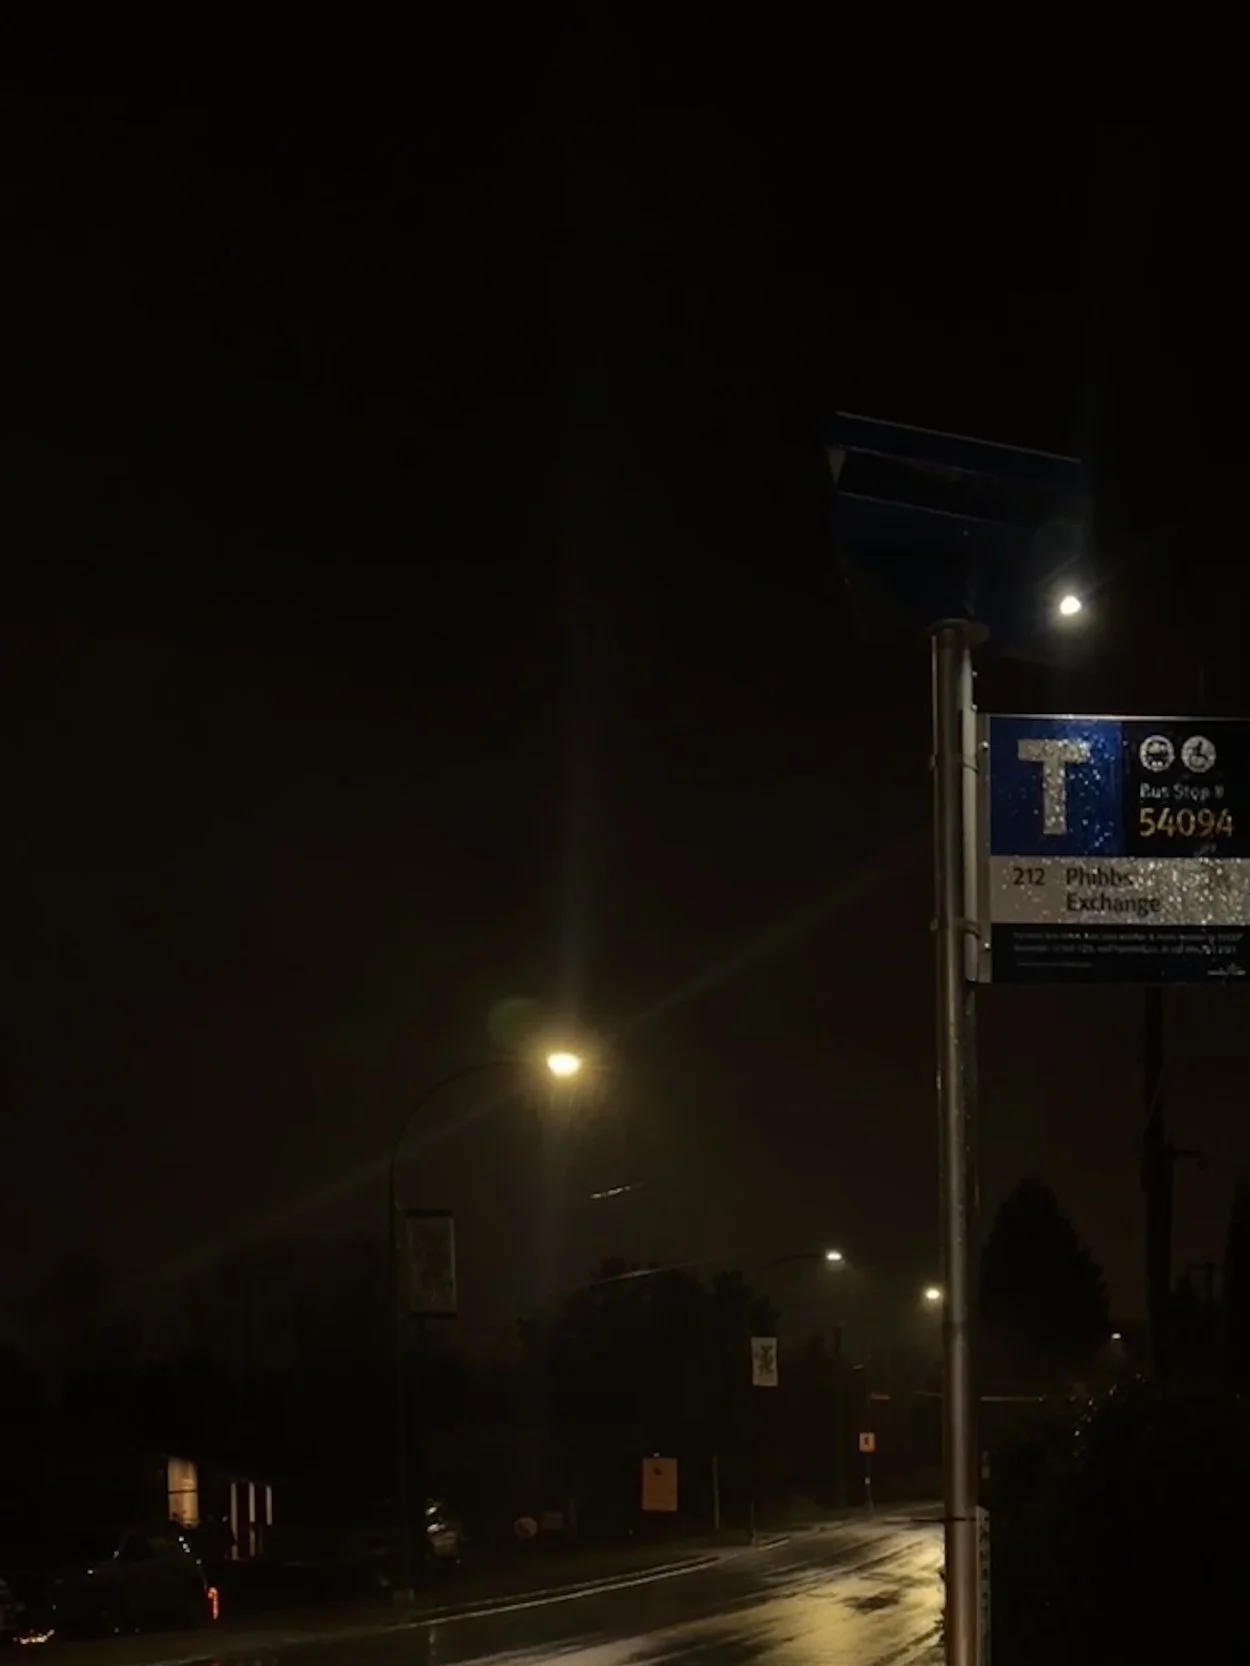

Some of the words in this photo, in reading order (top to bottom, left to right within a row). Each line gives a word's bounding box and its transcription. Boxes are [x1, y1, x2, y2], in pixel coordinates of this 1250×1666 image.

[1017, 738, 1091, 836] T
[1139, 782, 1168, 799] Bus
[1172, 783, 1211, 803] Stop
[1139, 807, 1236, 838] 54094
[1013, 867, 1046, 886] 212
[1066, 867, 1134, 887] Phibbs
[1066, 894, 1162, 918] Exchange
